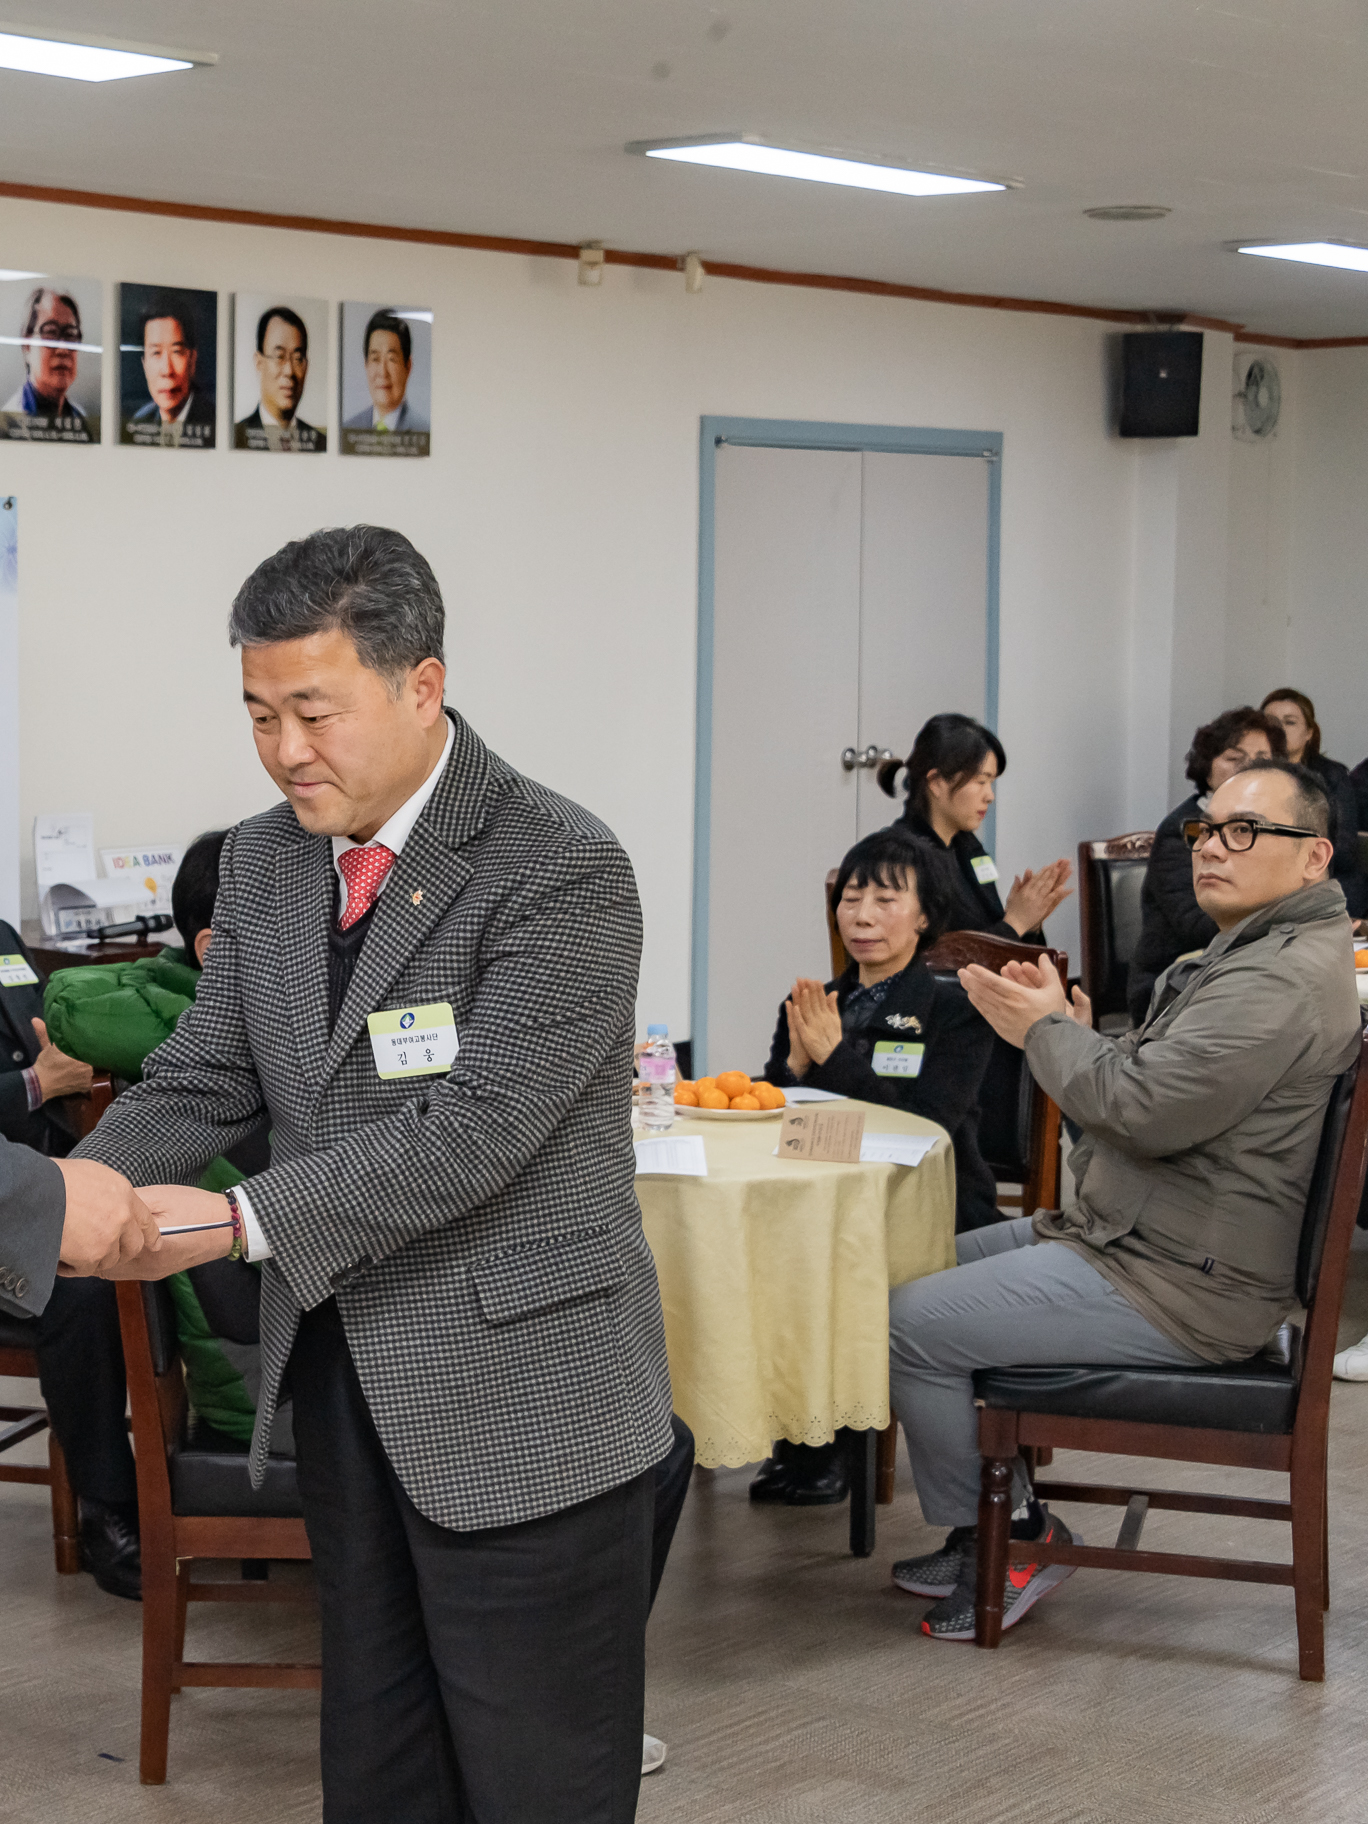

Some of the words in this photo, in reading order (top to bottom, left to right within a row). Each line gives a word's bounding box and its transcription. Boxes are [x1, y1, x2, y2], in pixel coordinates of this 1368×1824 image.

[142, 853, 174, 867] BANK
[397, 1051, 408, 1066] 김
[423, 1048, 435, 1062] 웅
